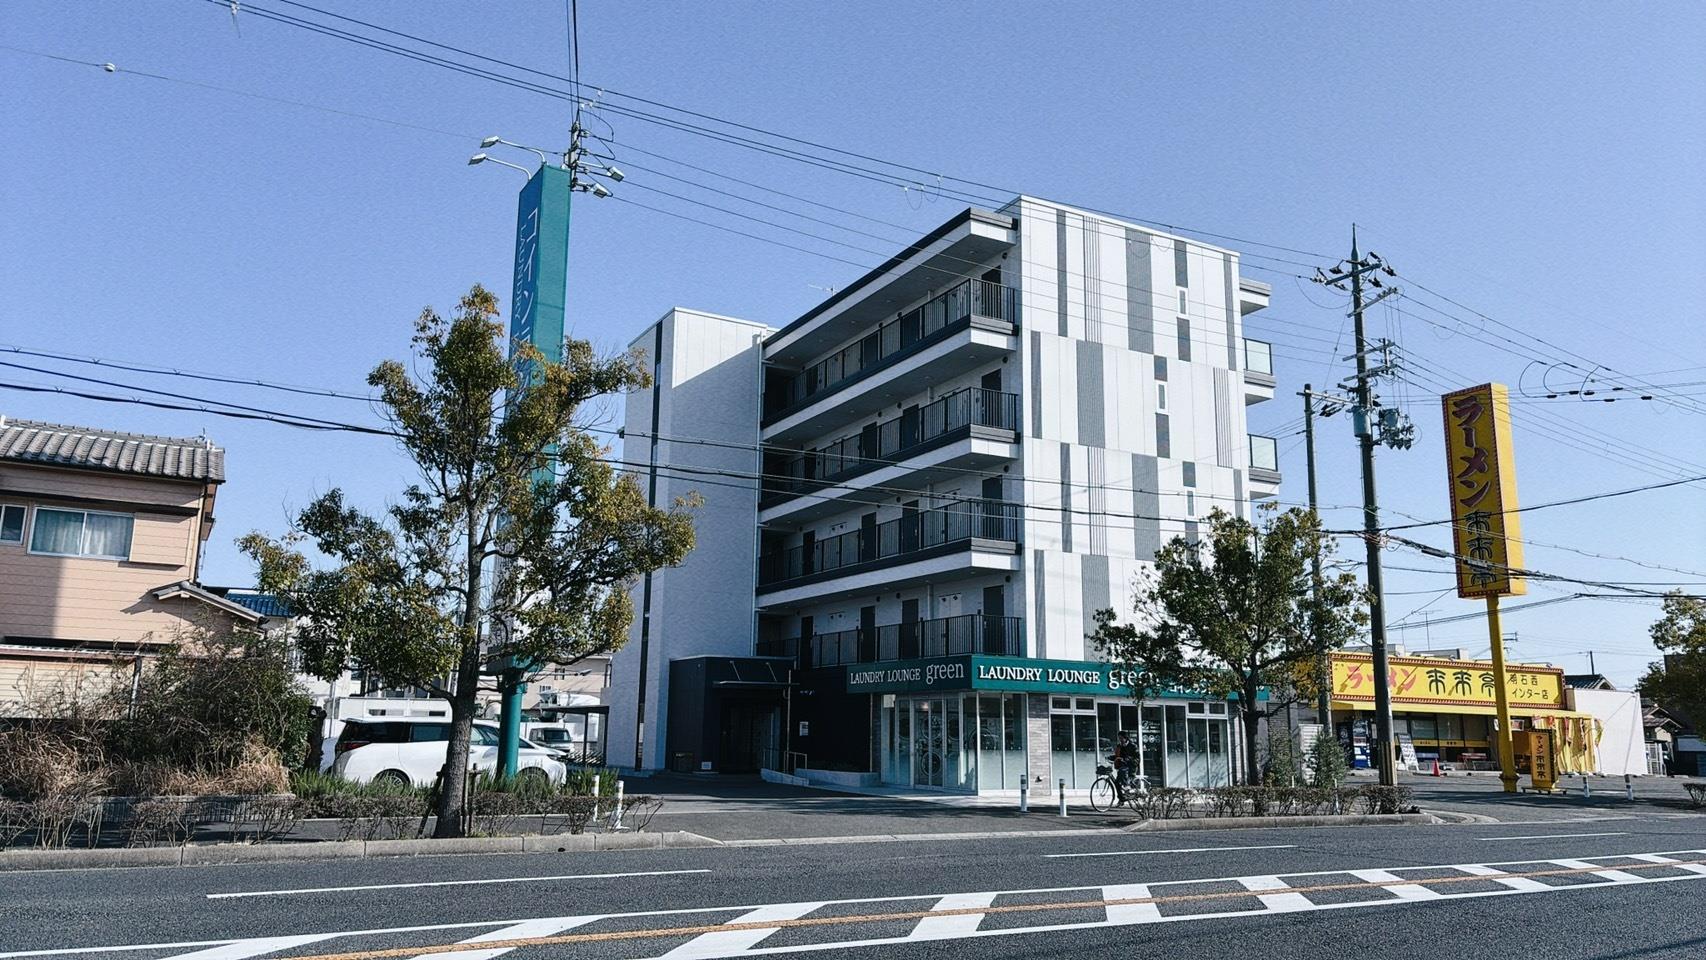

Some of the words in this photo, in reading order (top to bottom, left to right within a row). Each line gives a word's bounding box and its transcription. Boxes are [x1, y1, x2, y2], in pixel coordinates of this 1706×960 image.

[1452, 395, 1491, 508] ラーメン
[850, 669, 885, 685] LAUNDRY
[887, 668, 921, 683] LOUNGE
[926, 662, 964, 685] green
[979, 664, 1043, 682] LAUNDRY
[1048, 668, 1100, 685] LOUNGE
[1512, 688, 1549, 700] インター店
